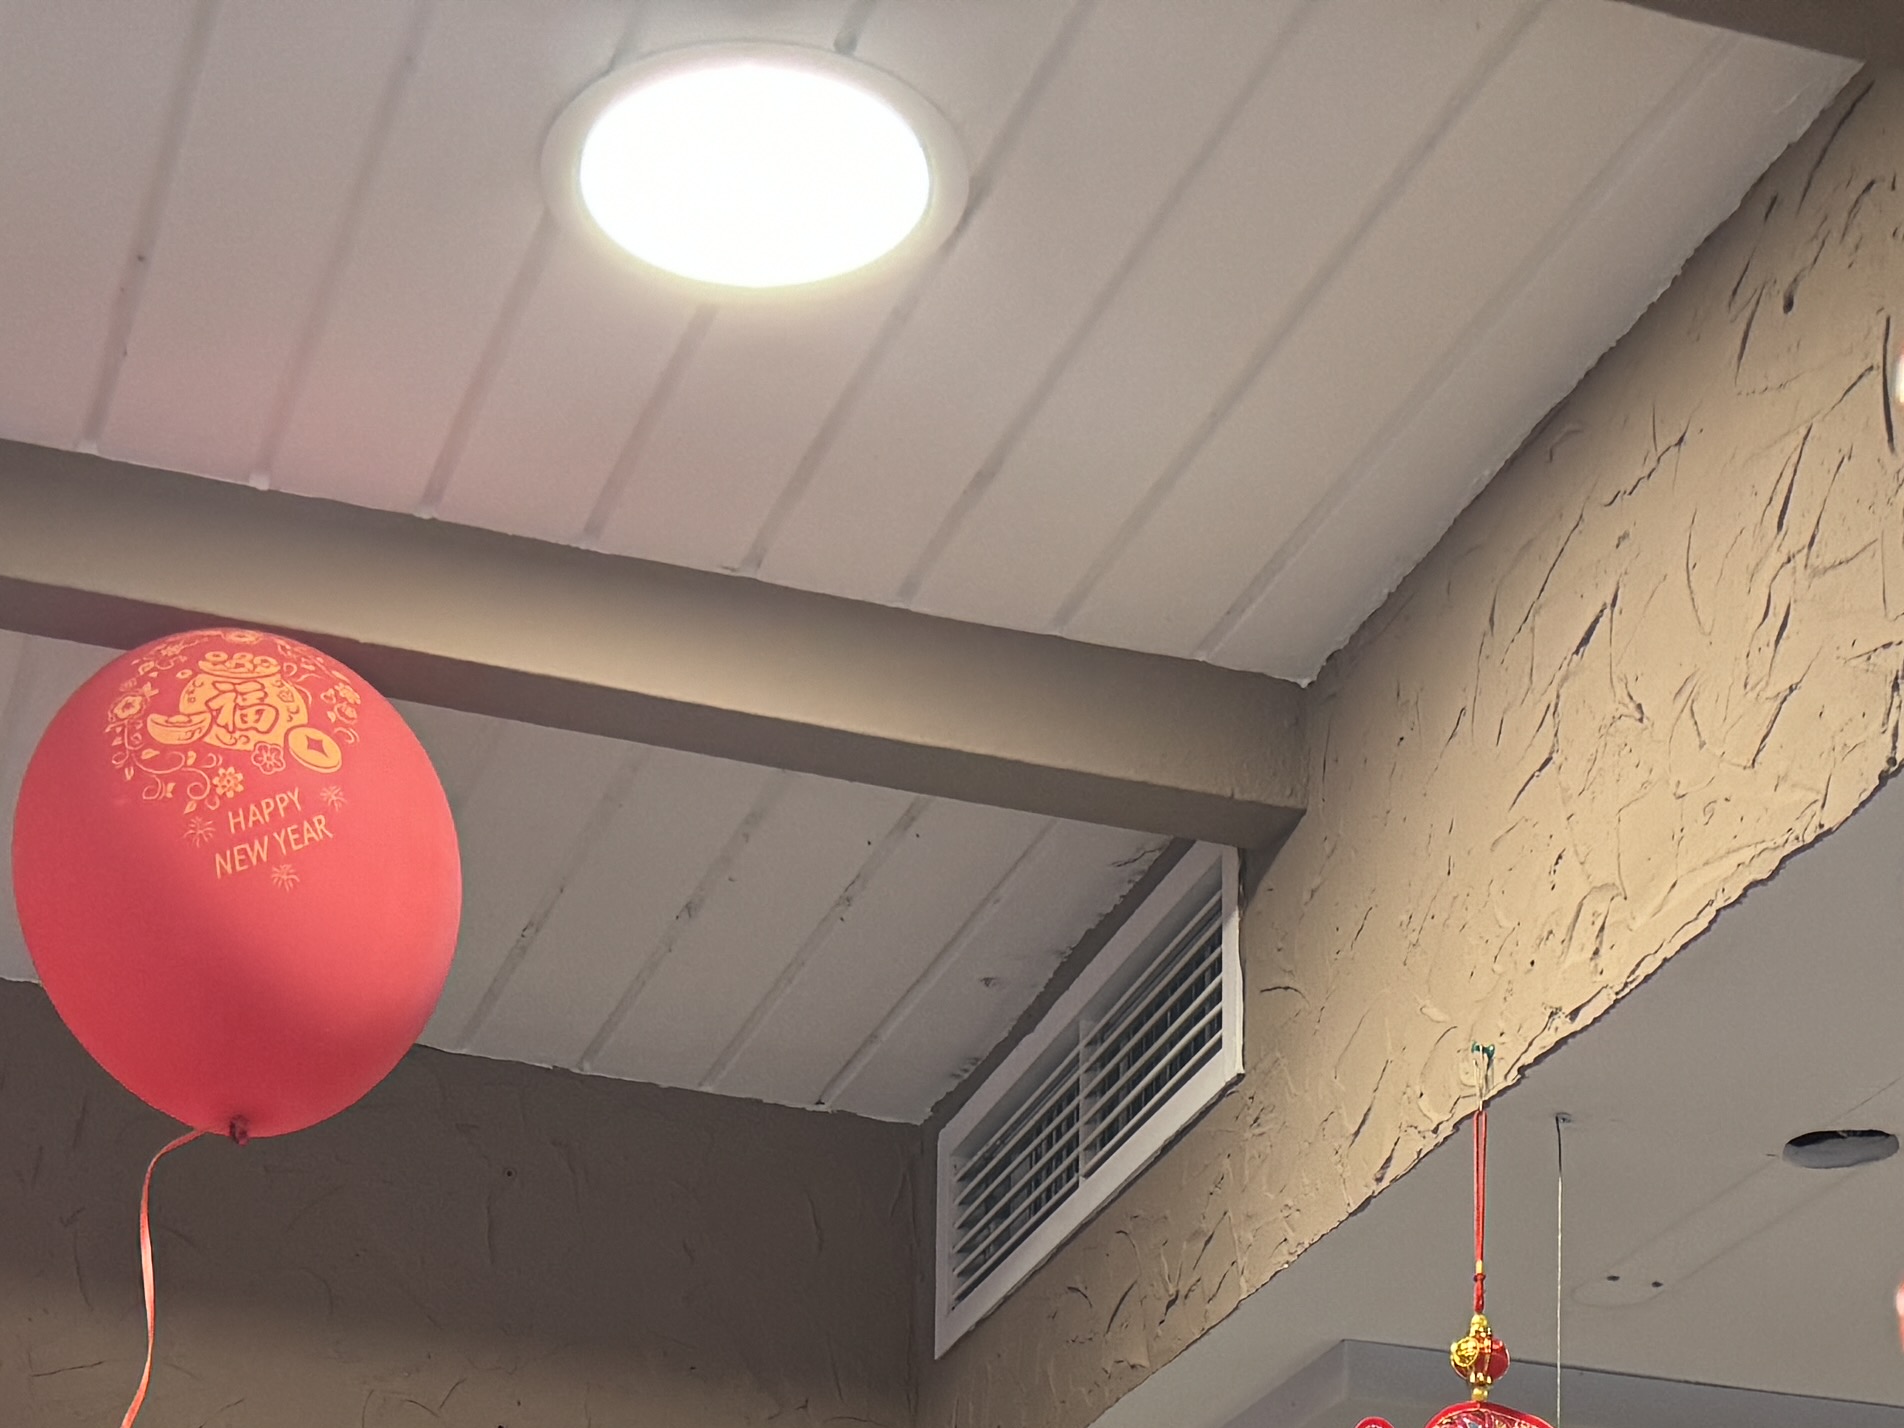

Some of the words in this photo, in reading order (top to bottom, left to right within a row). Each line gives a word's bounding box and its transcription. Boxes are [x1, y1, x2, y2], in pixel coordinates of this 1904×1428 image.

[205, 679, 280, 734] 福
[228, 787, 303, 834] HAPPY
[215, 835, 269, 880] NEW
[273, 814, 334, 856] YEAR
